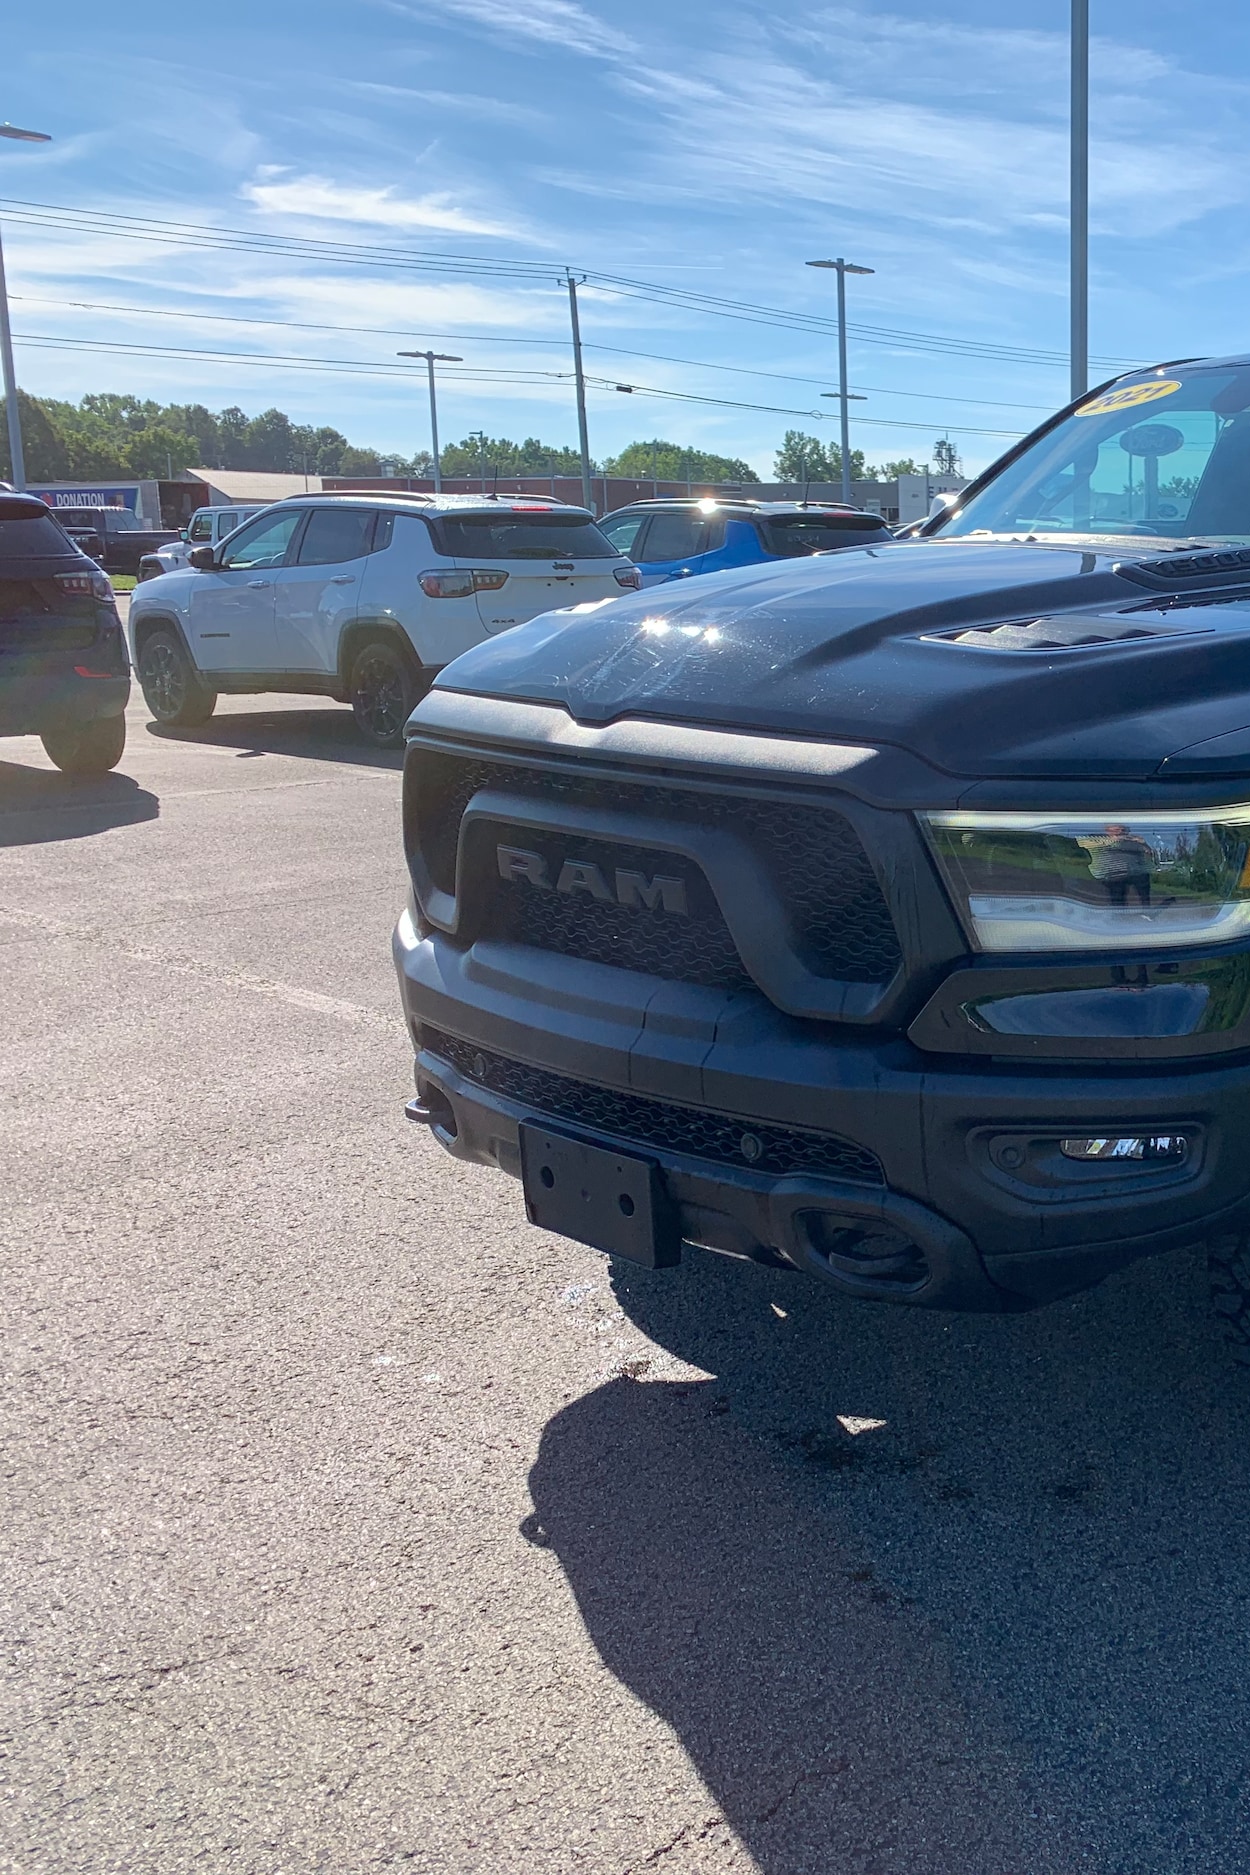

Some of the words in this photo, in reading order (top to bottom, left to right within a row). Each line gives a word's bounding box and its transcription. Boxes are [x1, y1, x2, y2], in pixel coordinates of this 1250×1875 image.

[1081, 383, 1172, 413] 2021
[55, 492, 105, 507] DONATION
[496, 843, 689, 917] RAM
